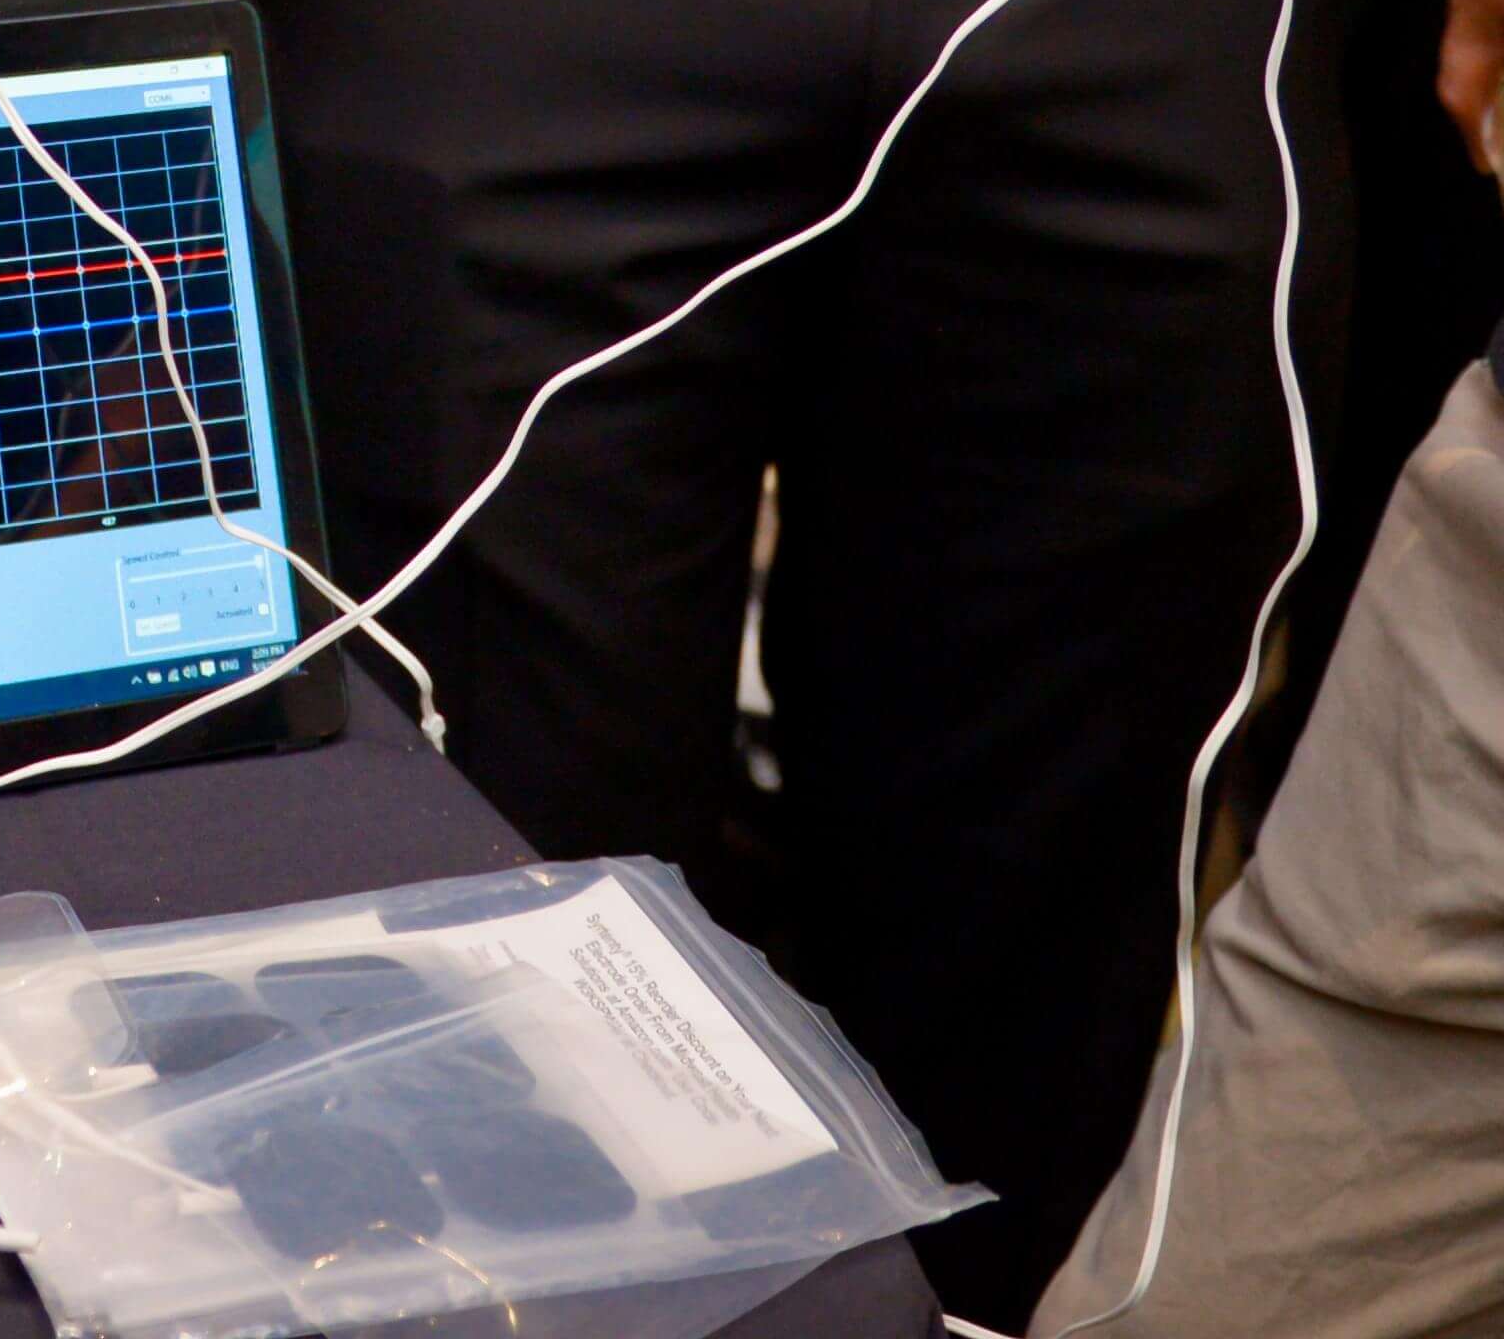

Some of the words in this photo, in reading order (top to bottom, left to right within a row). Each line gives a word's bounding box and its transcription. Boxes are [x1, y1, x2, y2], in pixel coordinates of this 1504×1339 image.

[220, 659, 240, 672] ENG
[568, 946, 611, 994] Solutions
[608, 991, 623, 1007] at
[584, 939, 628, 989] Electrode
[623, 985, 654, 1017] Order
[647, 1014, 676, 1046] From
[643, 980, 683, 1027] Reorder
[675, 1021, 722, 1071] Discount
[715, 1067, 732, 1087] on
